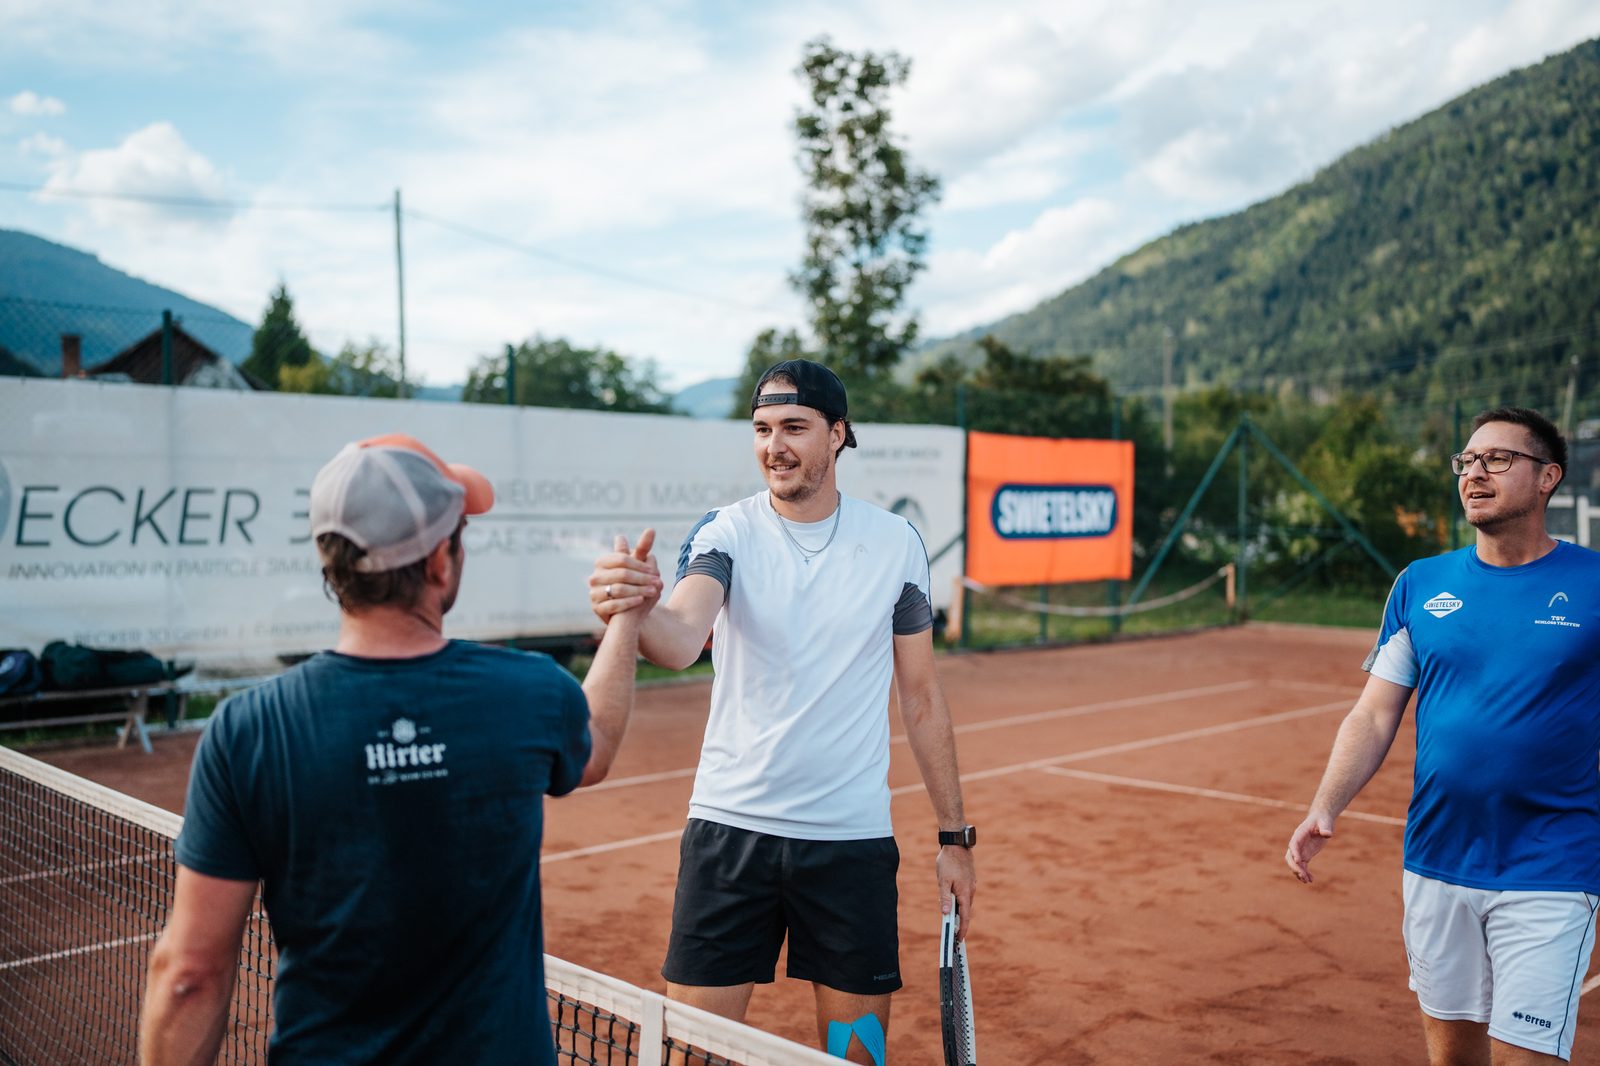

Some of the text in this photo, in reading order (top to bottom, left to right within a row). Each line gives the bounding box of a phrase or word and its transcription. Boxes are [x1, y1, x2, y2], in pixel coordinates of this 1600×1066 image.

[15, 485, 261, 547] ECKER
[998, 489, 1115, 534] SWIETELSKY
[8, 560, 146, 581] INNOVATION
[1424, 601, 1461, 609] SWIETELSKY
[364, 742, 447, 770] Hirter
[873, 971, 897, 981] HEAD
[1525, 1013, 1552, 1029] errea
